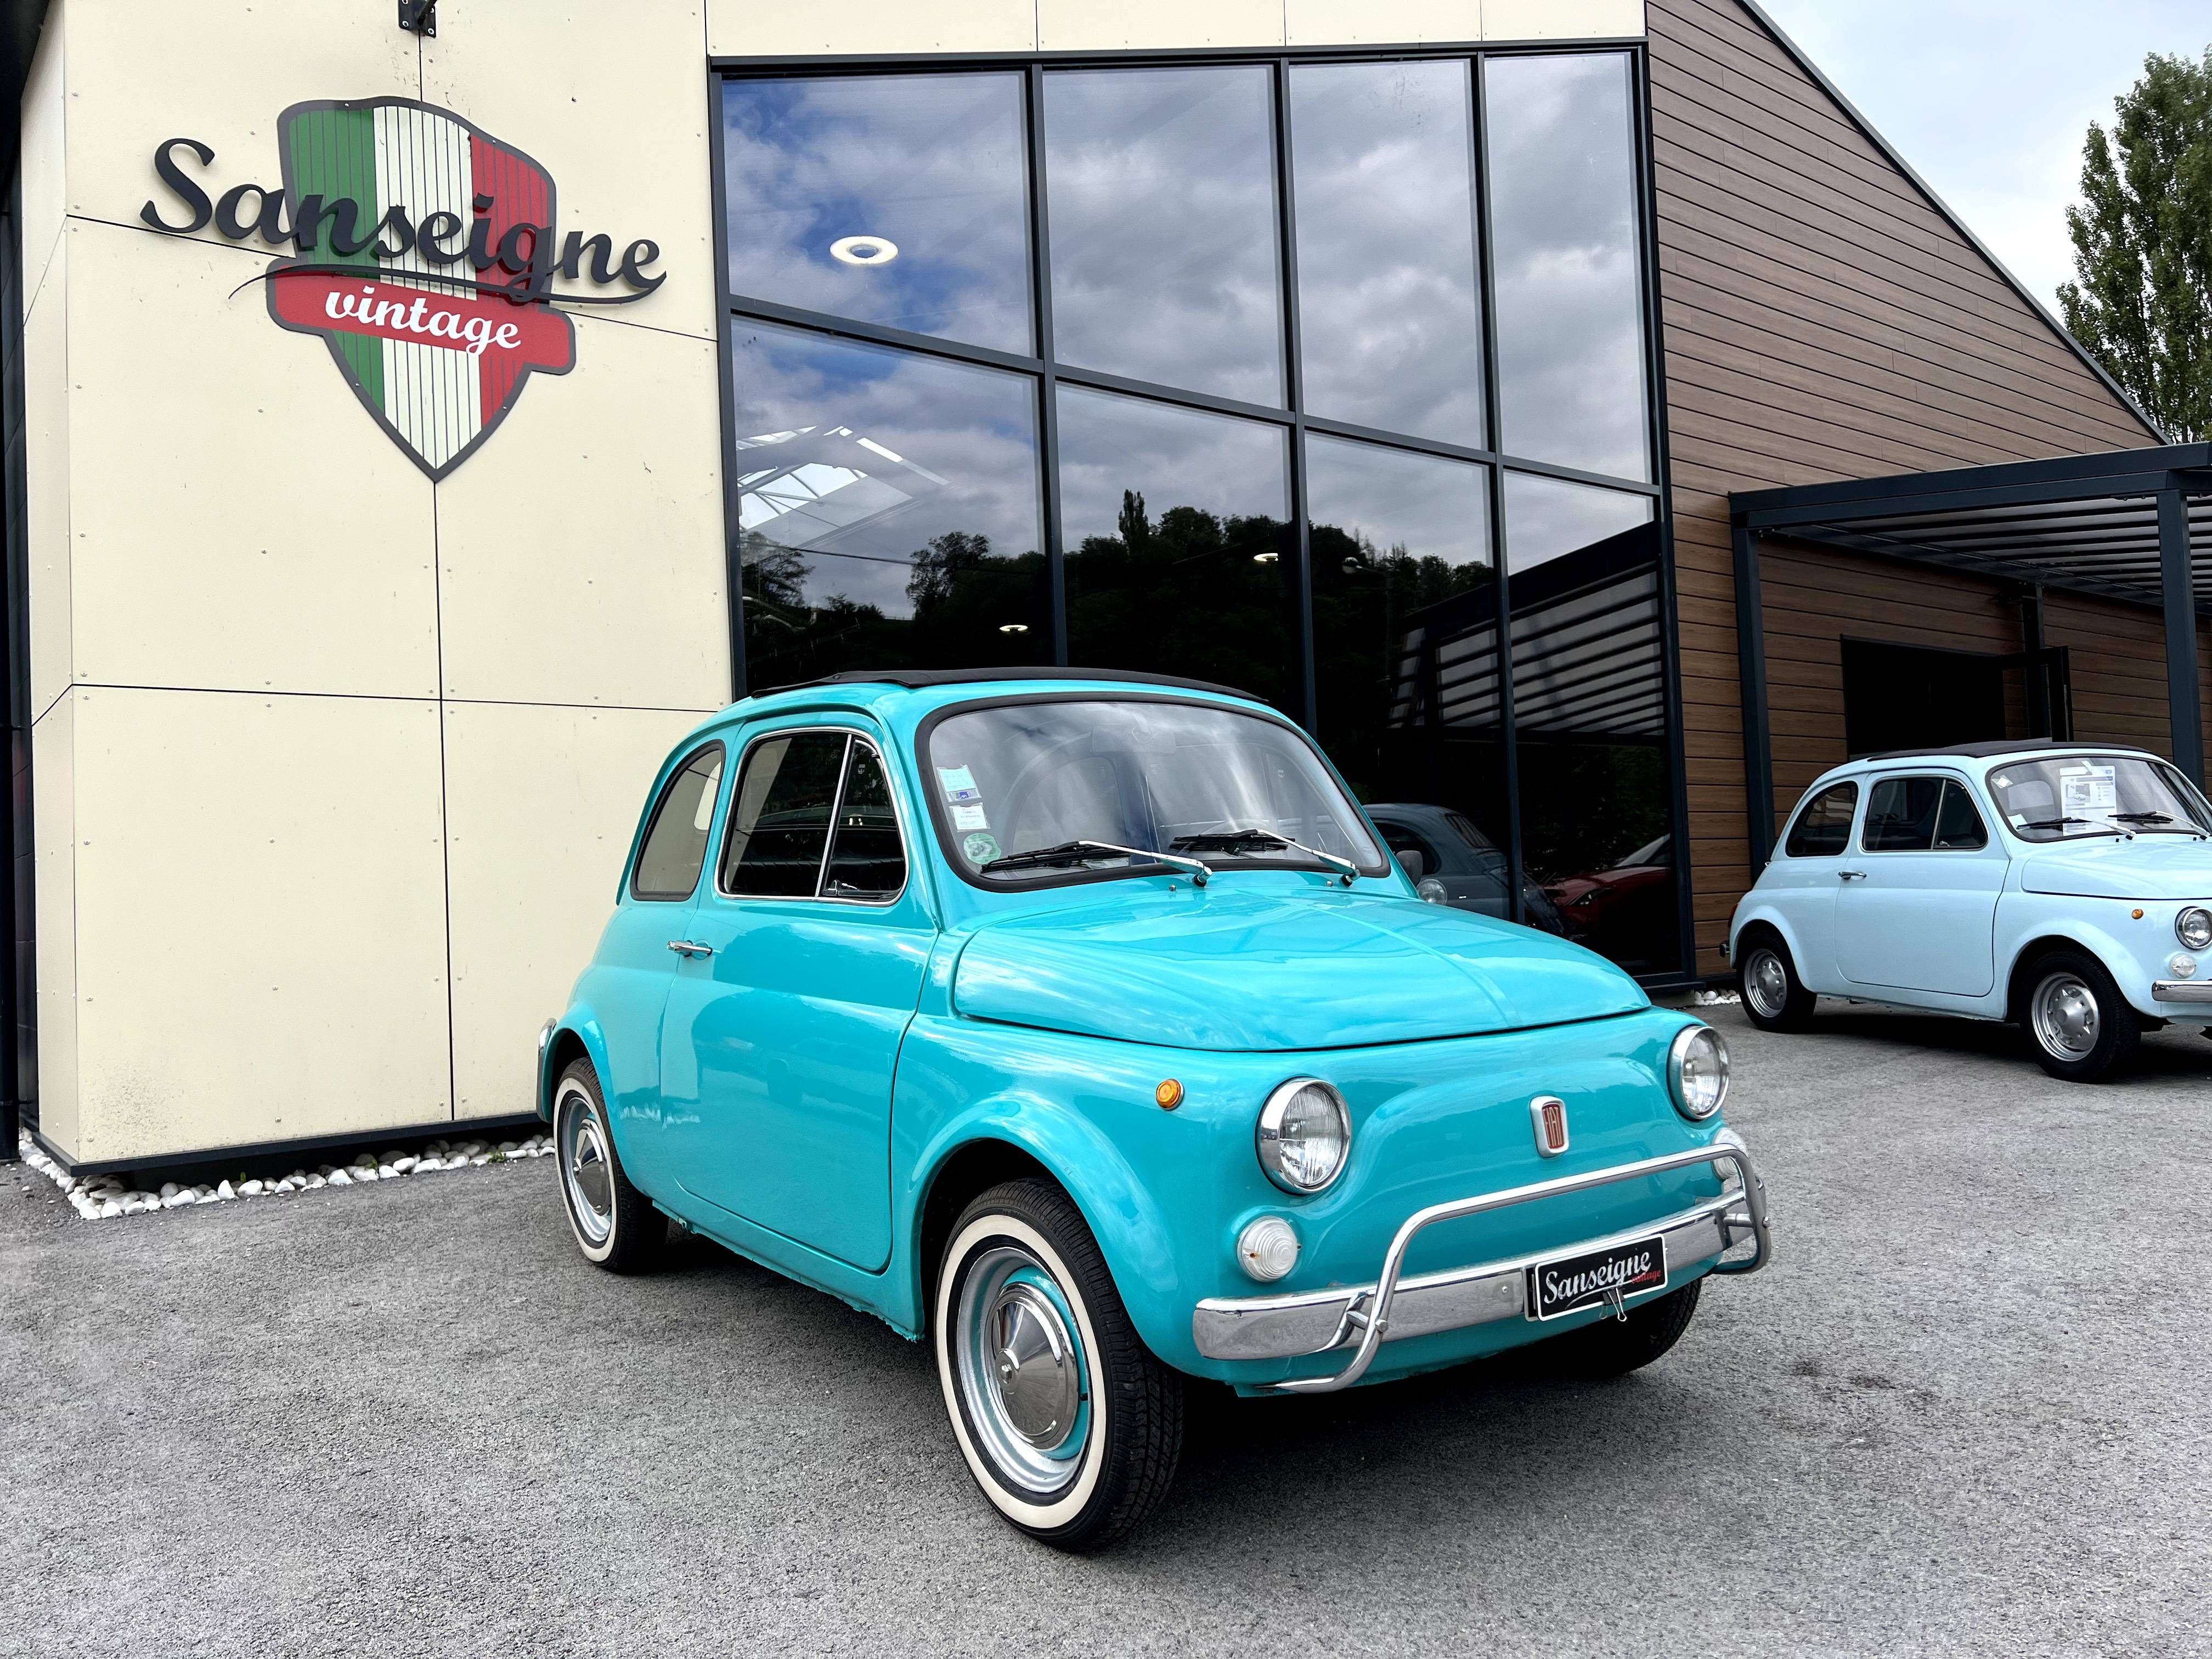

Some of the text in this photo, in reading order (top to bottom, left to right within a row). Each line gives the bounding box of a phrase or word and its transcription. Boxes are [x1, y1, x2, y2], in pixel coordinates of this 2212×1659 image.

[140, 138, 667, 303] Sanseigne
[325, 286, 521, 356] vintage
[1544, 1251, 1652, 1304] Sanseigne
